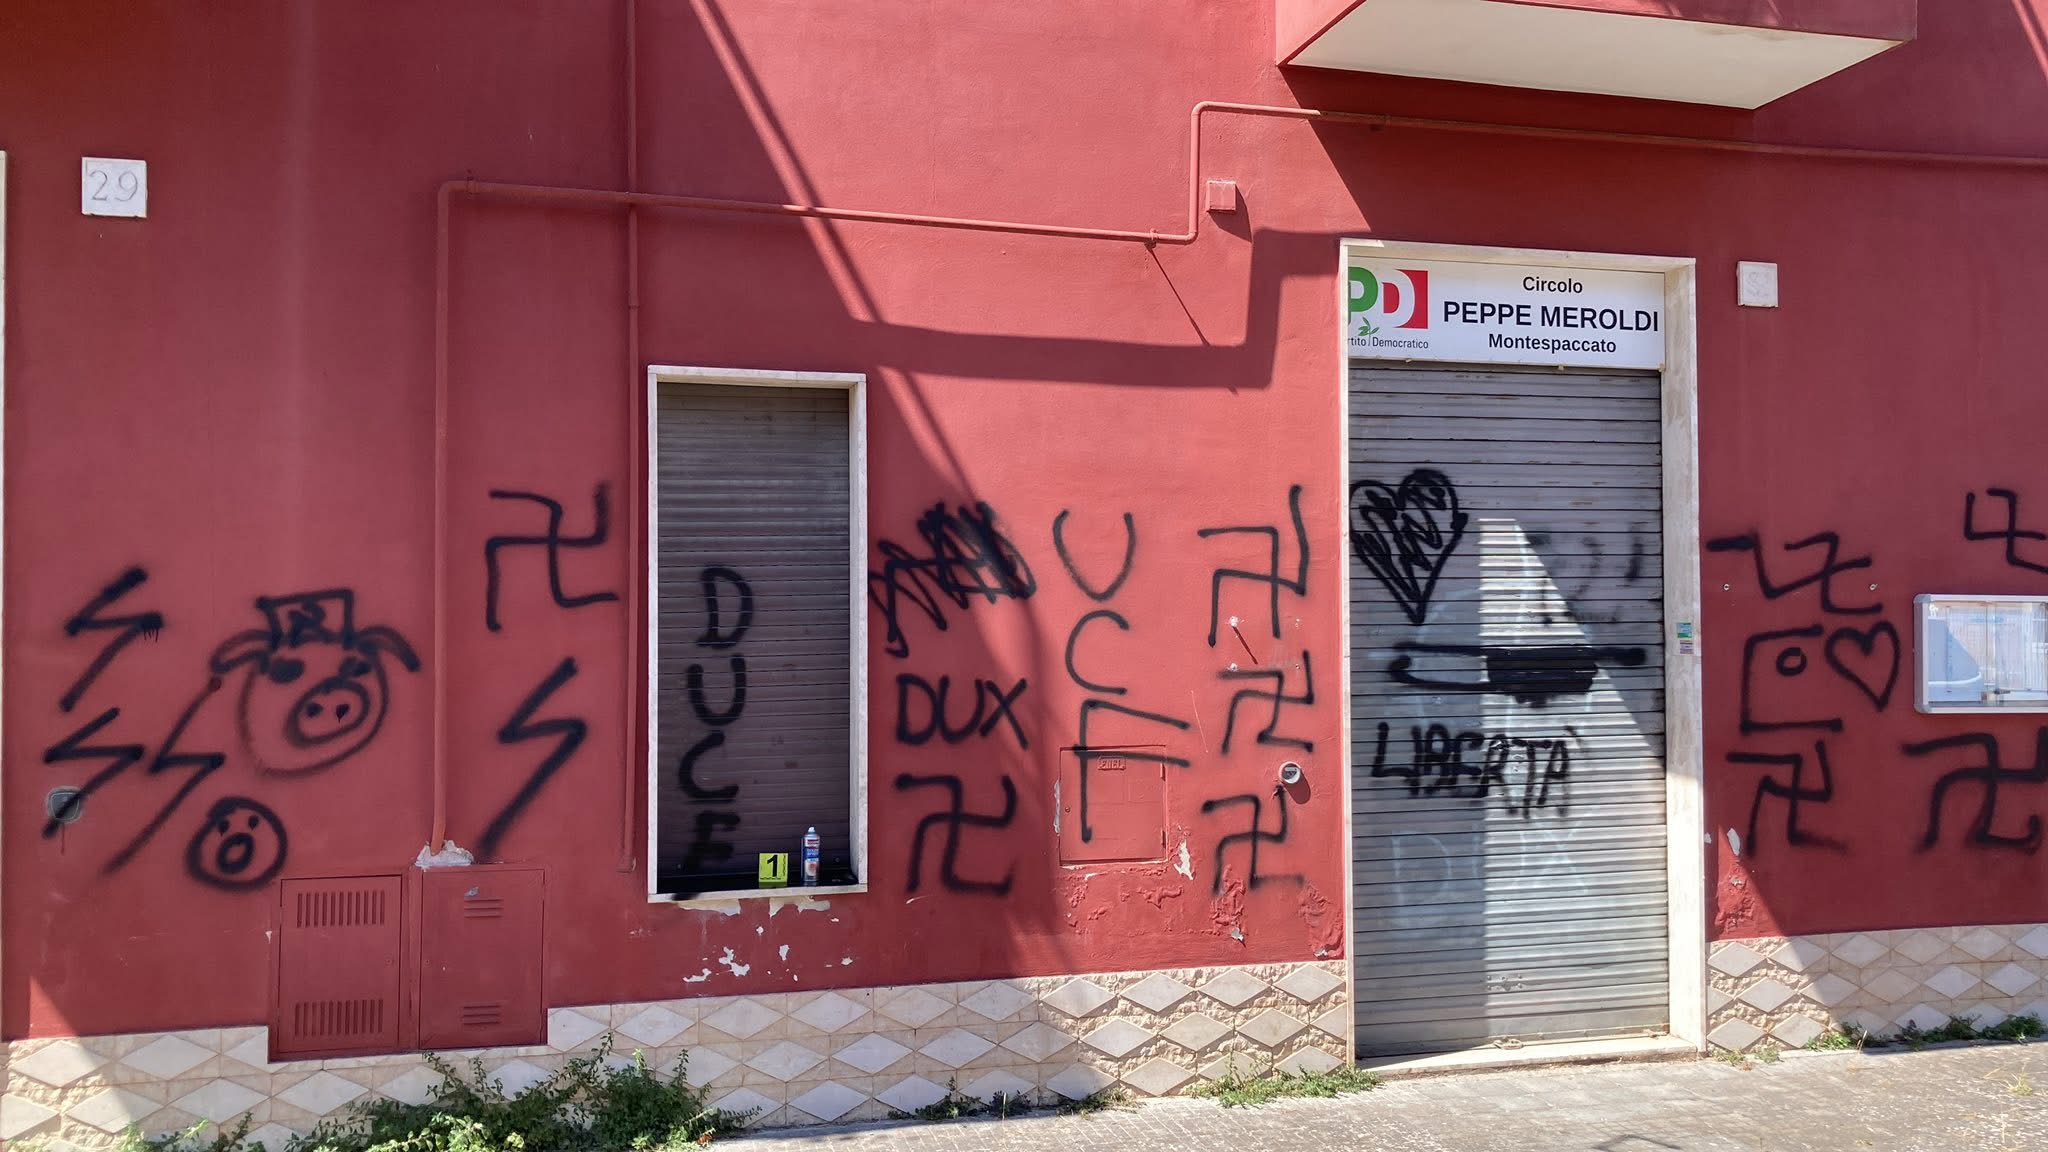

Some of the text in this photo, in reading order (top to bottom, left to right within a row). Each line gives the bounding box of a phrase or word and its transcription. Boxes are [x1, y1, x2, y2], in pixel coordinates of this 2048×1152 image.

[89, 170, 138, 202] 29
[1522, 276, 1583, 294] Circolo
[1443, 300, 1659, 332] PEPPE MEROLDI
[1372, 336, 1429, 349] Democratico
[1488, 333, 1617, 354] Montespaccato
[896, 673, 1030, 750] DUX
[767, 854, 779, 877] 1
